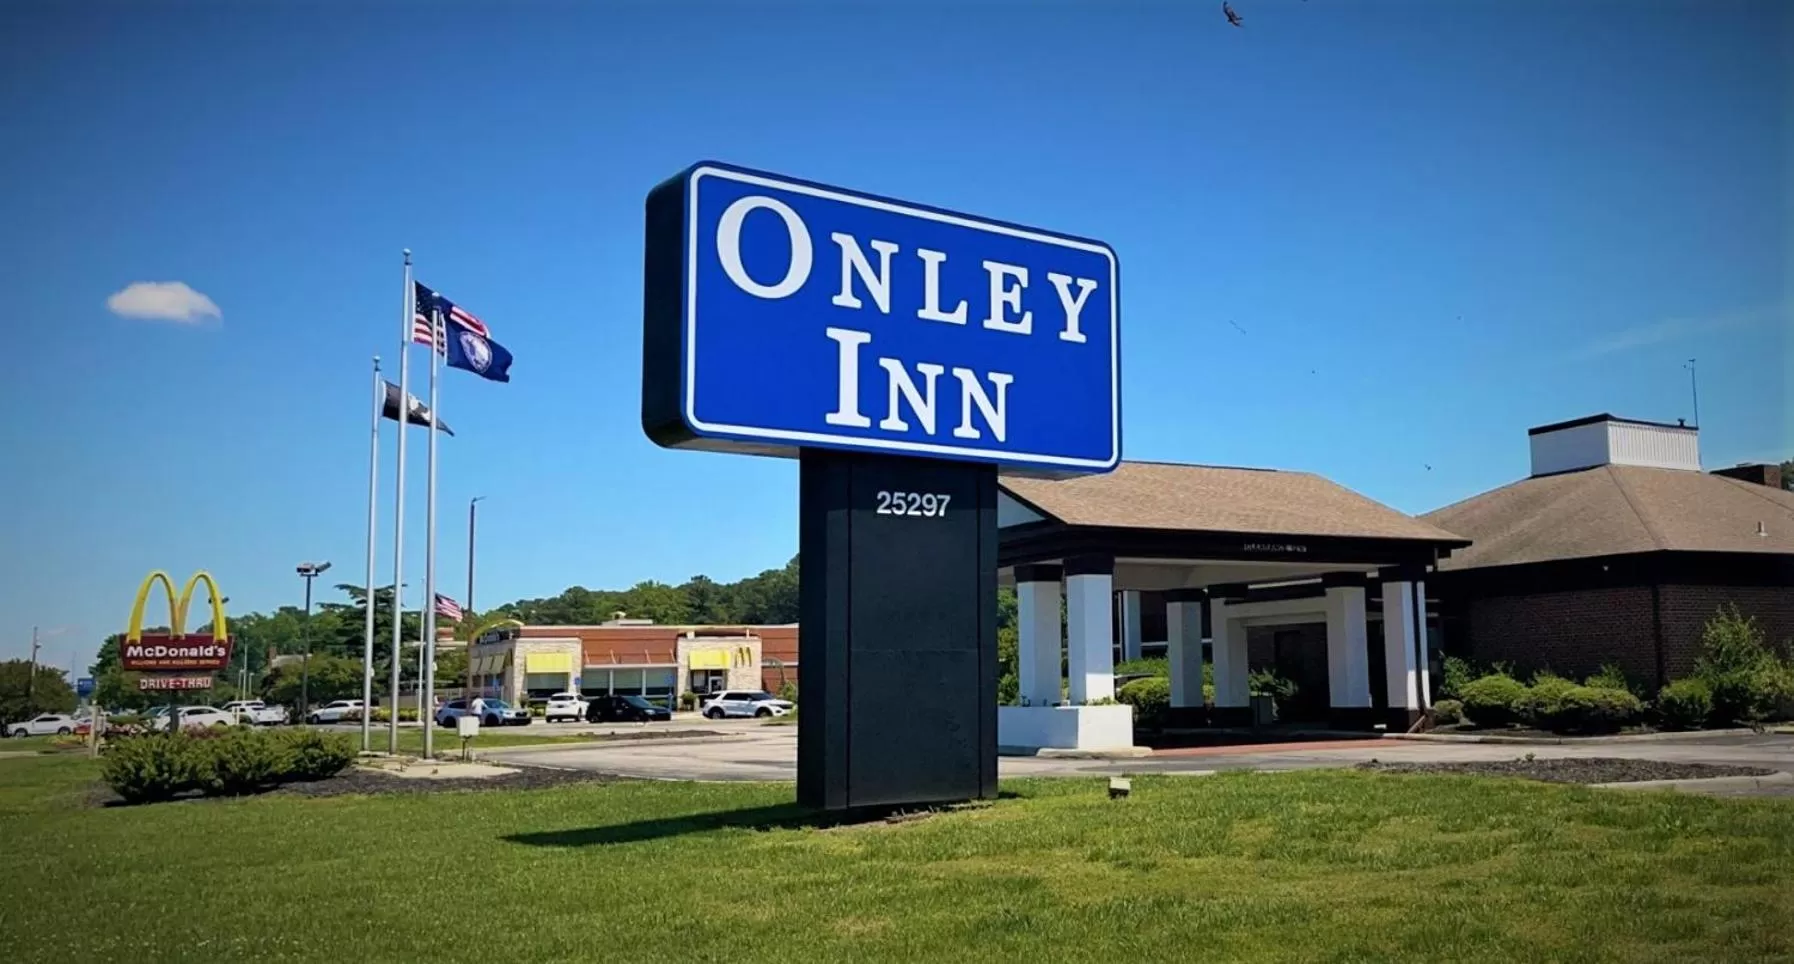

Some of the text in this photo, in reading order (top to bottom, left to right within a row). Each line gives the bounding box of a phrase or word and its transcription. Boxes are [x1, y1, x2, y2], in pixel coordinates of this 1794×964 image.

[716, 196, 1098, 343] ONLEY
[825, 327, 1014, 442] INN
[876, 491, 951, 517] 25297
[126, 645, 226, 658] McDonald's
[140, 677, 212, 691] DRIVE-THRU
